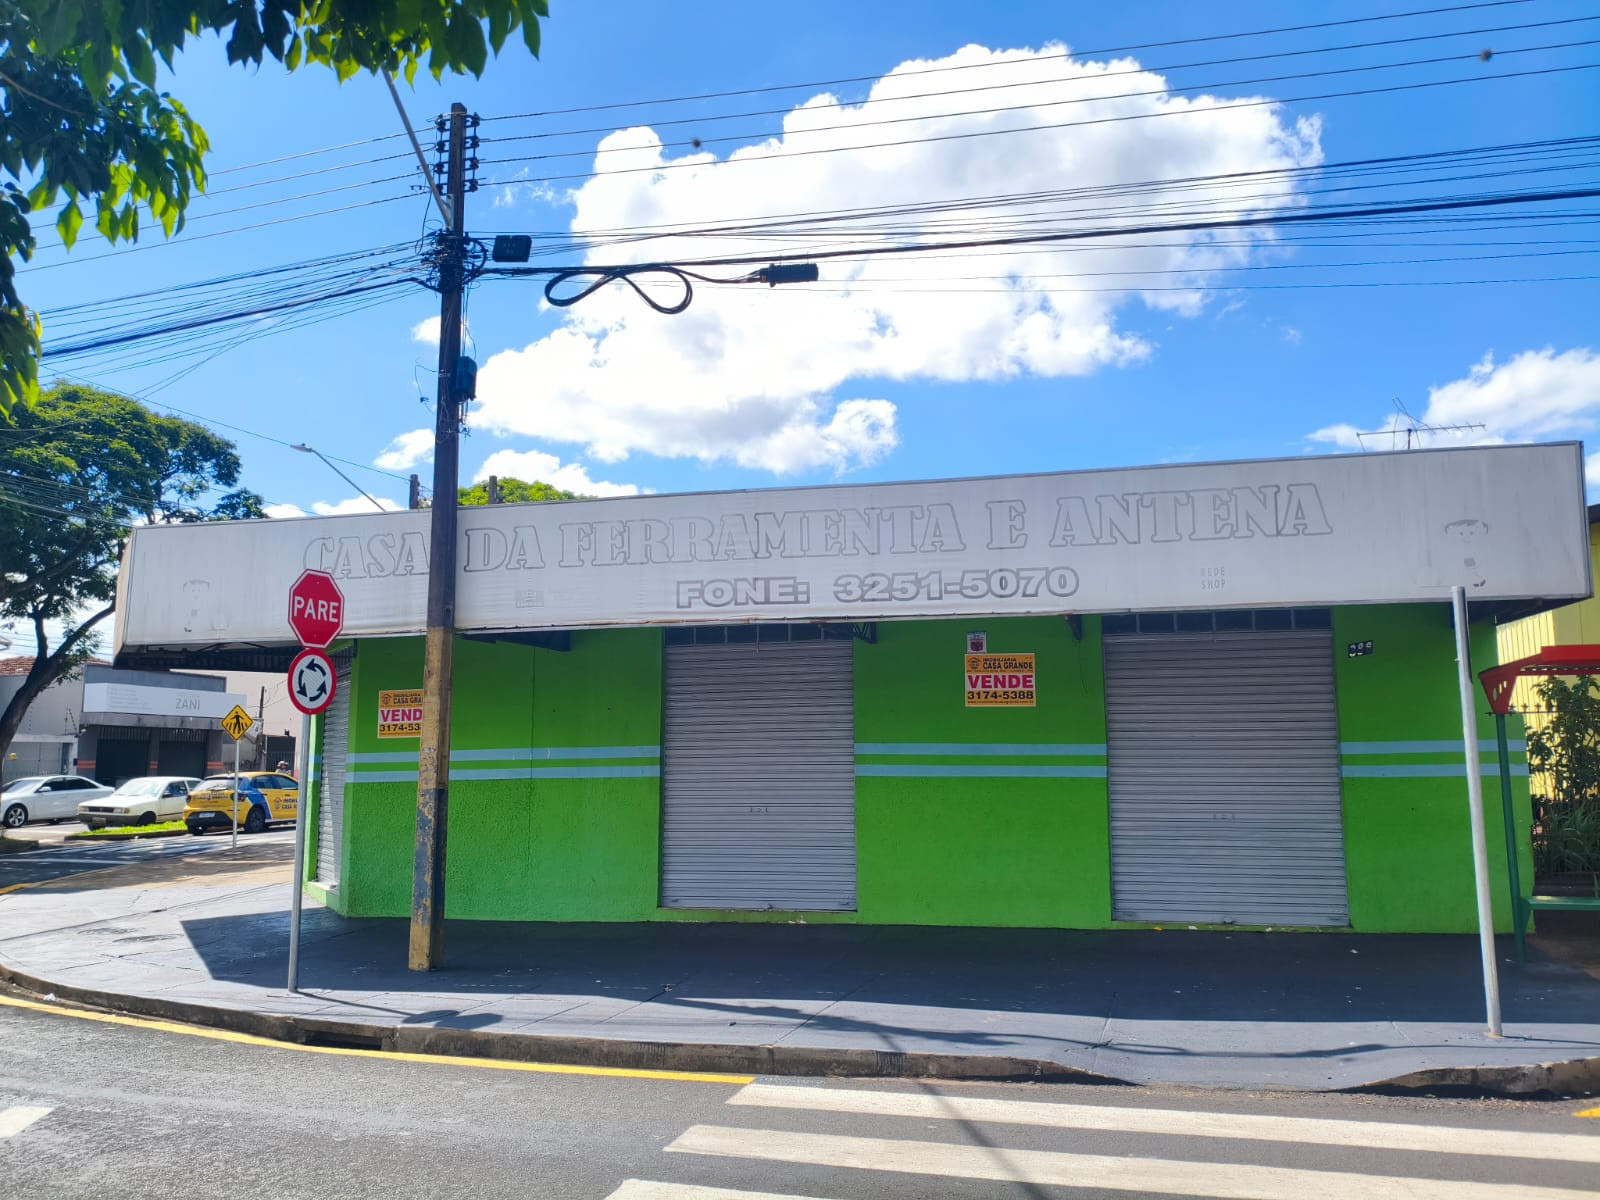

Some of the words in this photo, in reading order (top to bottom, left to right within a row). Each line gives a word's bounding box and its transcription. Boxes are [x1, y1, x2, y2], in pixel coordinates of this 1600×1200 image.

[303, 531, 430, 579] CASA
[463, 524, 545, 572] DA
[558, 502, 966, 567] FERRAMENTA
[985, 499, 1028, 550] E
[1048, 482, 1334, 548] ANTENA
[676, 576, 810, 609] FONE:
[833, 565, 1080, 604] 3251-5070
[293, 595, 339, 623] PARE
[983, 661, 1002, 670] CASA
[1004, 661, 1033, 670] GRANDE
[967, 674, 1034, 689] VENDE
[967, 690, 1034, 700] 3174-5388
[175, 697, 201, 711] ZANI
[380, 708, 423, 722] VEND
